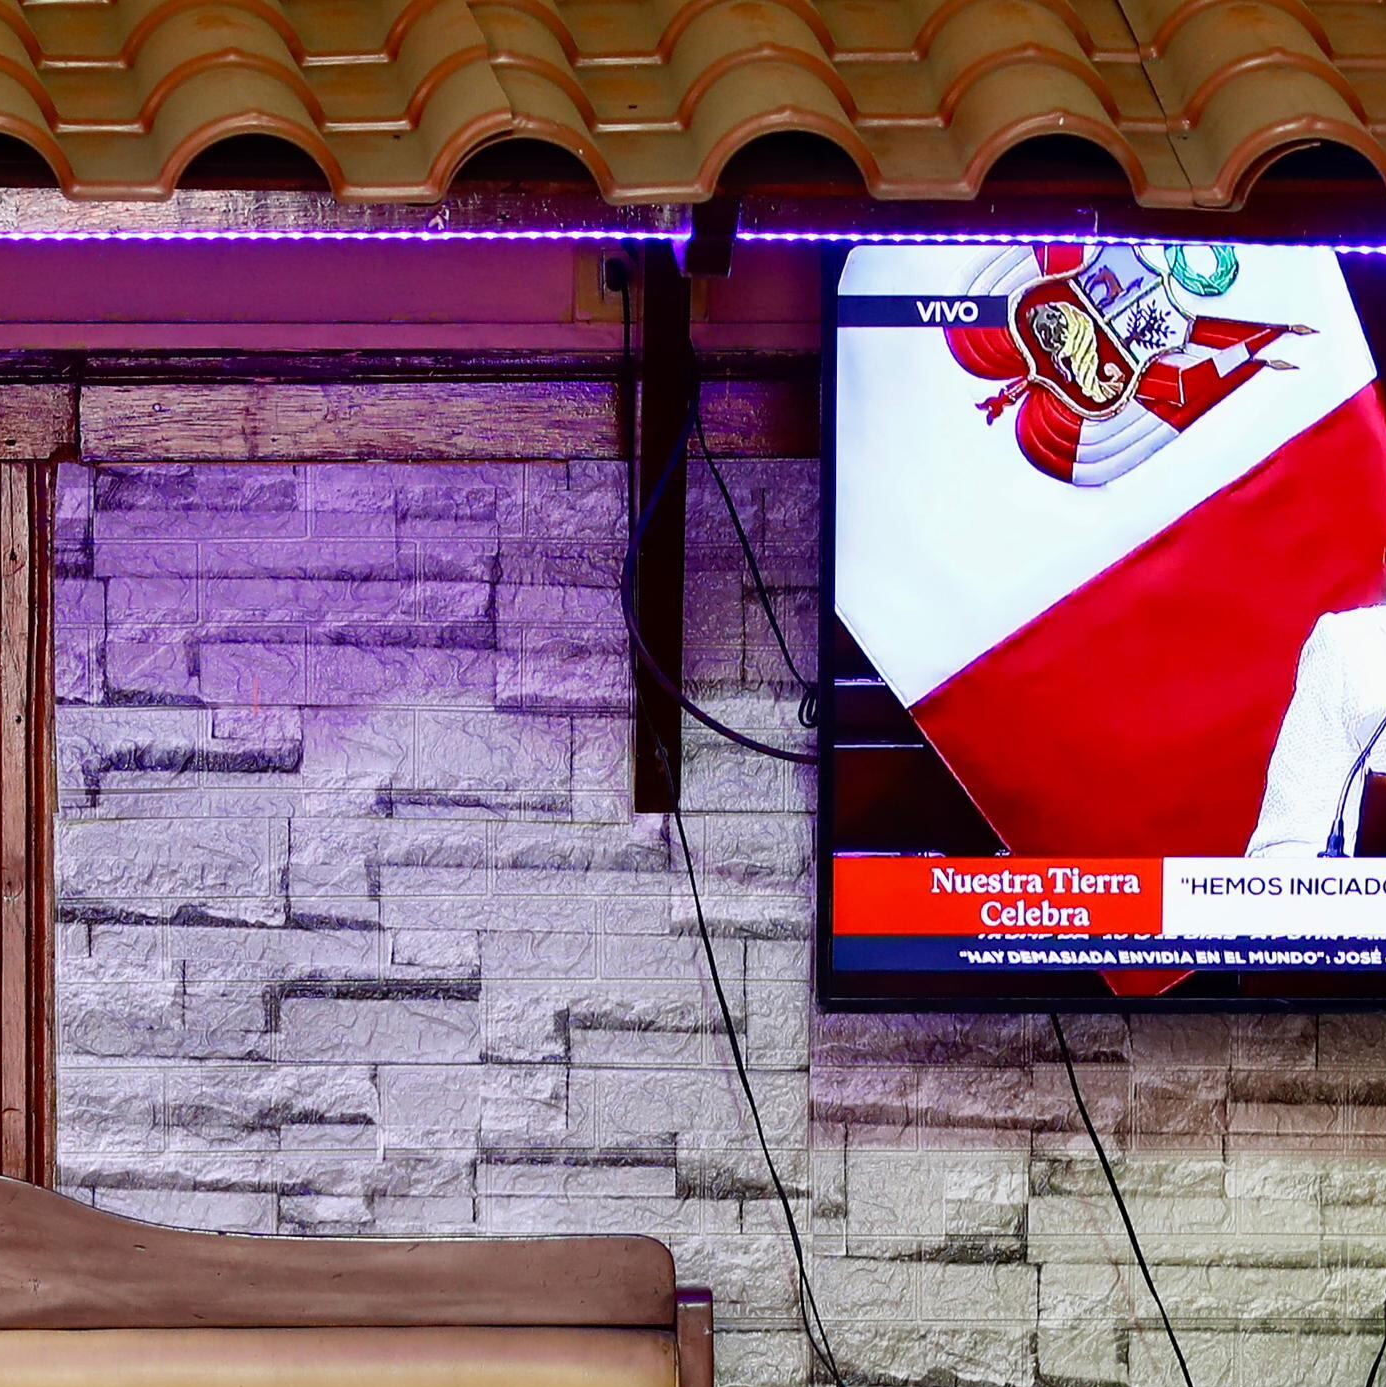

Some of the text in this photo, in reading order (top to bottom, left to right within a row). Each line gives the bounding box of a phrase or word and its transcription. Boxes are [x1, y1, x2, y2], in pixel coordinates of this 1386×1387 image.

[916, 300, 979, 323] VIVO
[931, 867, 1140, 894] Nuestra Tierra
[1181, 877, 1283, 896] "HEMOS
[980, 899, 1090, 927] Celebra
[959, 949, 1004, 964] "HAY
[1007, 950, 1118, 964] DEMASIADA
[1118, 950, 1194, 964] ENVIDIA
[1196, 950, 1221, 964] EN
[1223, 950, 1247, 965] EL
[1333, 946, 1383, 965] JOSÉ
